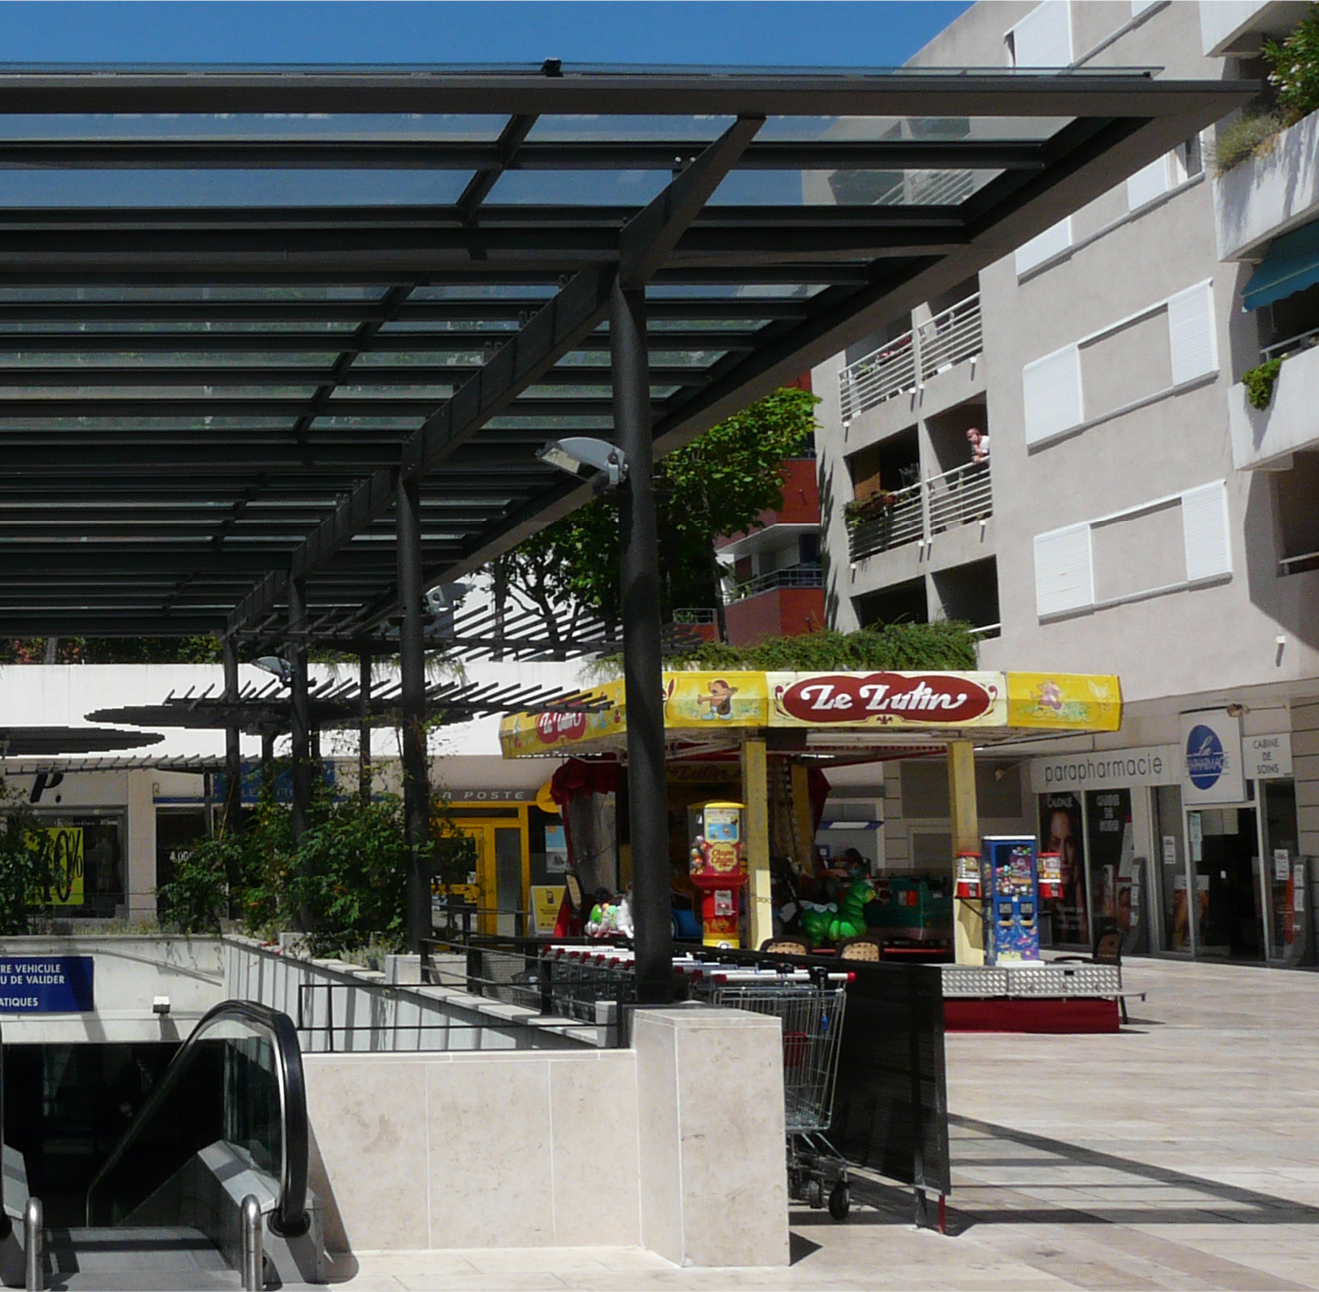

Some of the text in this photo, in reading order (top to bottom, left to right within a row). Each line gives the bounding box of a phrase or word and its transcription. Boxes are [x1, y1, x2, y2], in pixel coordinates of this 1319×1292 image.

[800, 681, 968, 710] Le Lutin
[1045, 753, 1162, 786] parapharmacie
[1257, 763, 1279, 774] SOINS
[30, 771, 64, 804] P.
[464, 791, 525, 800] POSTE
[32, 829, 83, 902] 40%
[14, 963, 61, 974] VEHICULE
[10, 975, 23, 985] DE
[25, 974, 65, 985] VALIDER
